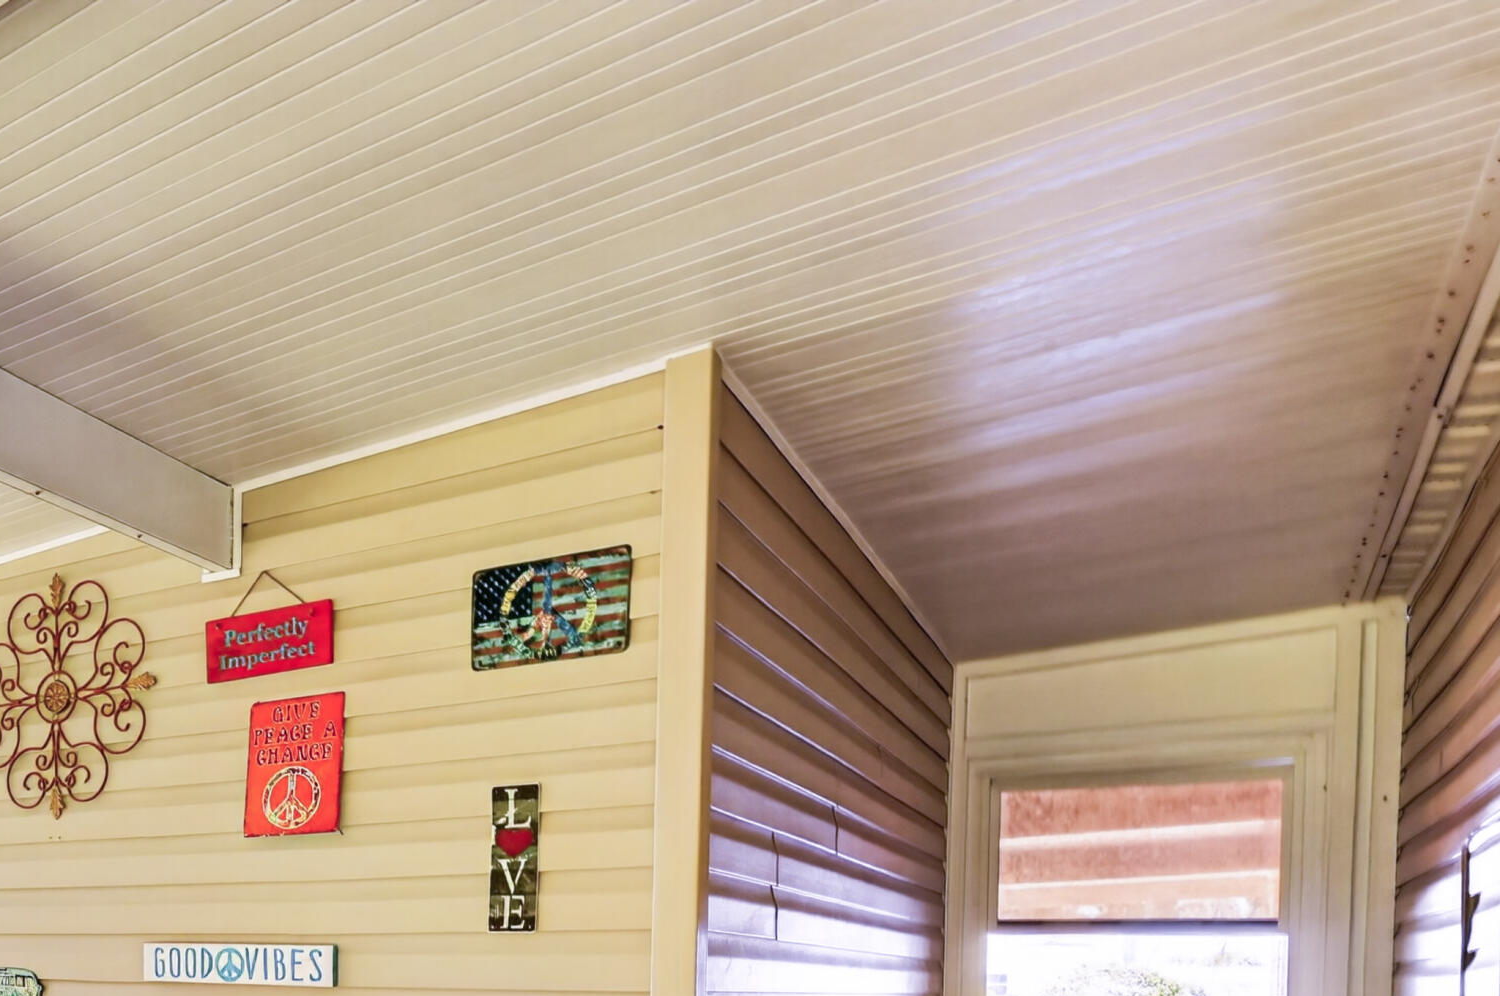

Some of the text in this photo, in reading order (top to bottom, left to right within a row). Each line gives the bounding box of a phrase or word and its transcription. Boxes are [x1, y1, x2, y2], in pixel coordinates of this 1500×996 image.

[224, 616, 308, 647] Perfectly
[219, 641, 315, 670] Imperfect
[273, 701, 320, 723] GIVE
[254, 720, 337, 746] PEACE A
[257, 742, 332, 766] CHANCE
[496, 788, 532, 929] LVE
[154, 946, 322, 982] GOOD VIBES
